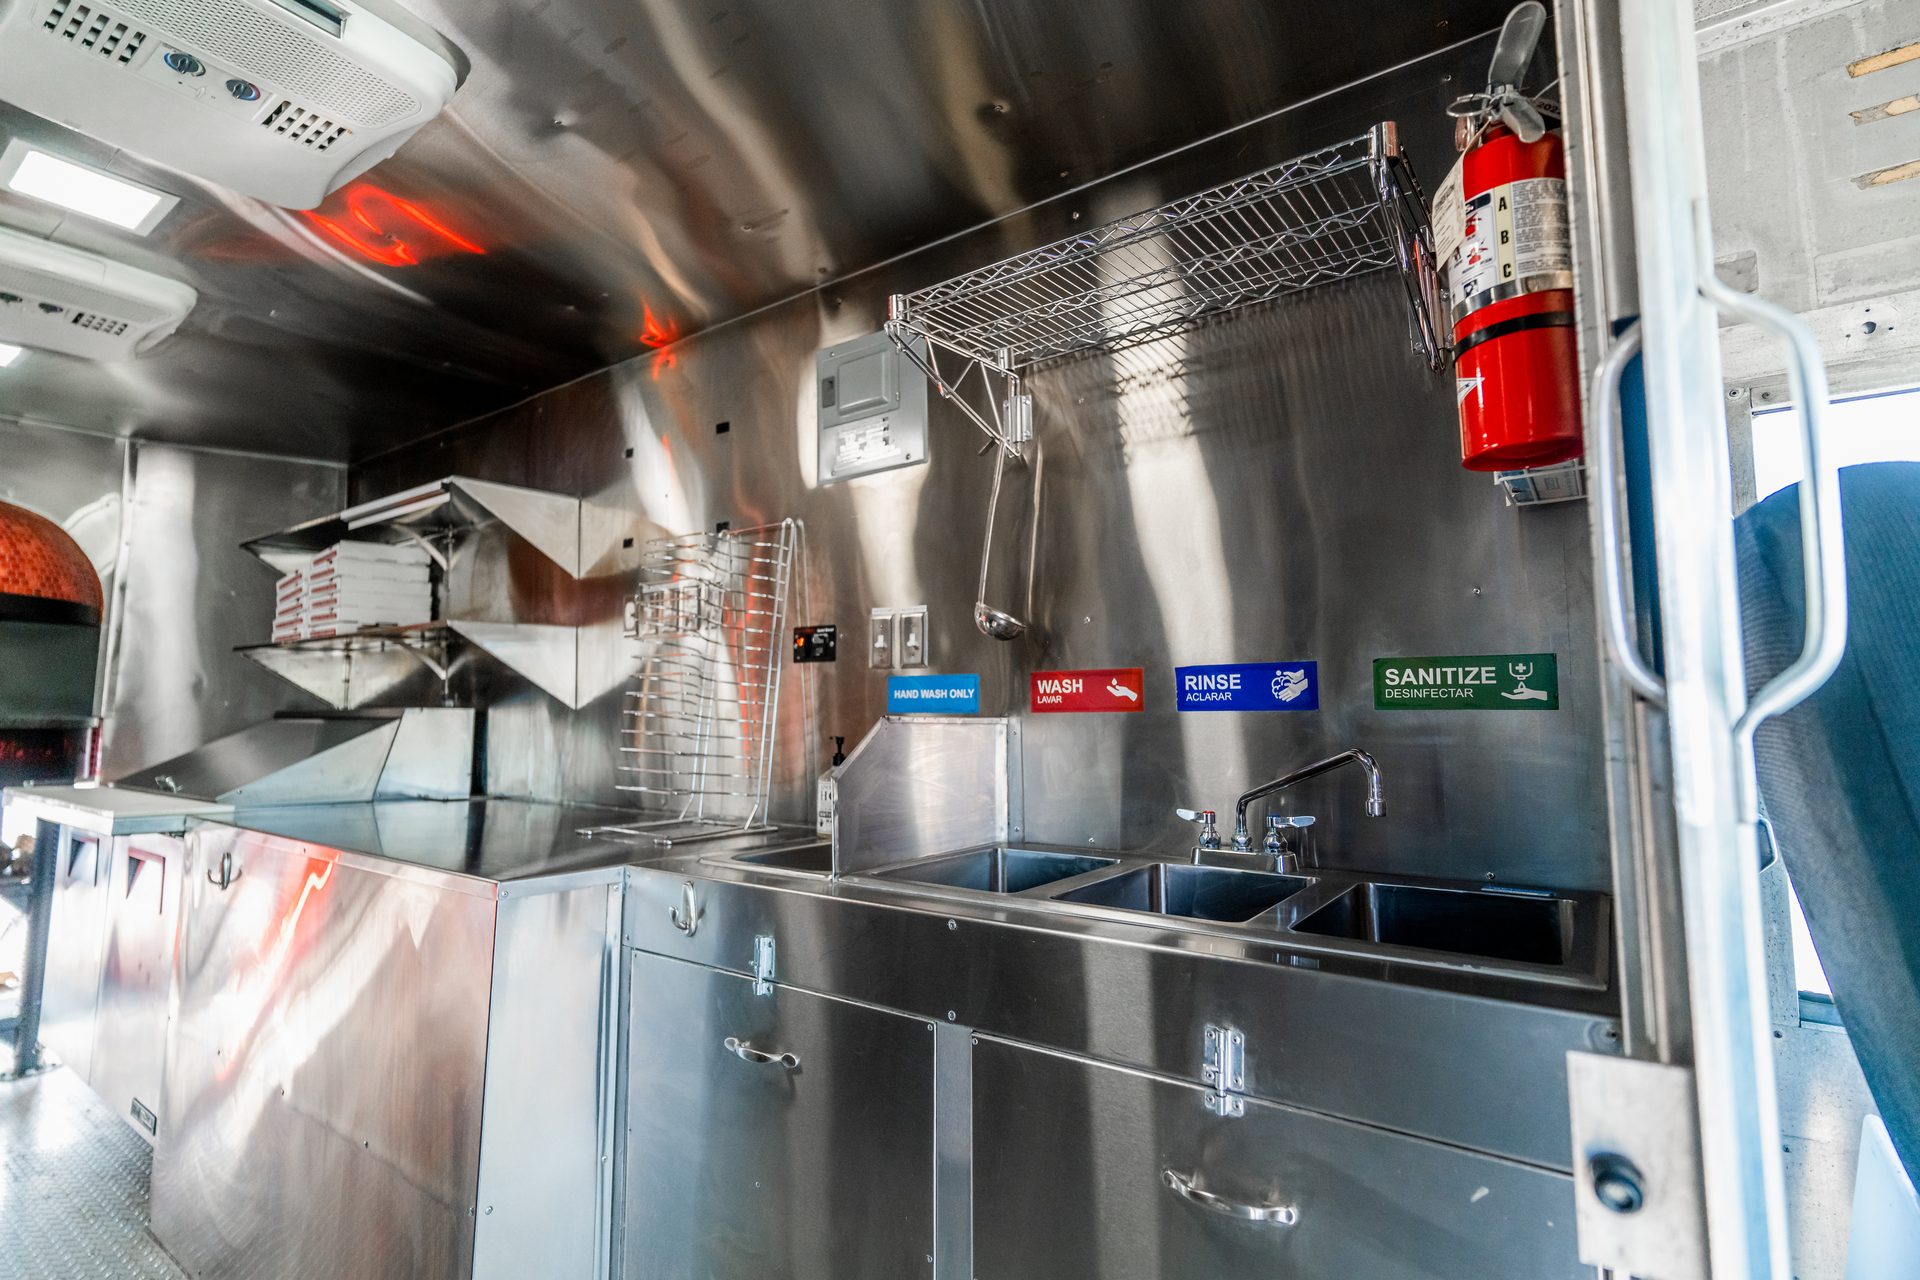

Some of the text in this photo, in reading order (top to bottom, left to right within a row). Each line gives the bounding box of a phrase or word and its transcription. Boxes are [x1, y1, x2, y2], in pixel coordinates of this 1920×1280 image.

[1498, 196, 1508, 212] A
[1500, 229, 1510, 245] B
[1502, 263, 1512, 278] C
[1184, 673, 1242, 691] RINSE
[1385, 666, 1497, 686] SANITIZE
[893, 688, 975, 699] HAND WASH ONLY
[1037, 678, 1083, 694] WASH
[1385, 687, 1474, 700] DESINFECTAR
[1037, 695, 1063, 704] LAVAR
[1185, 691, 1233, 702] ACLARAR
